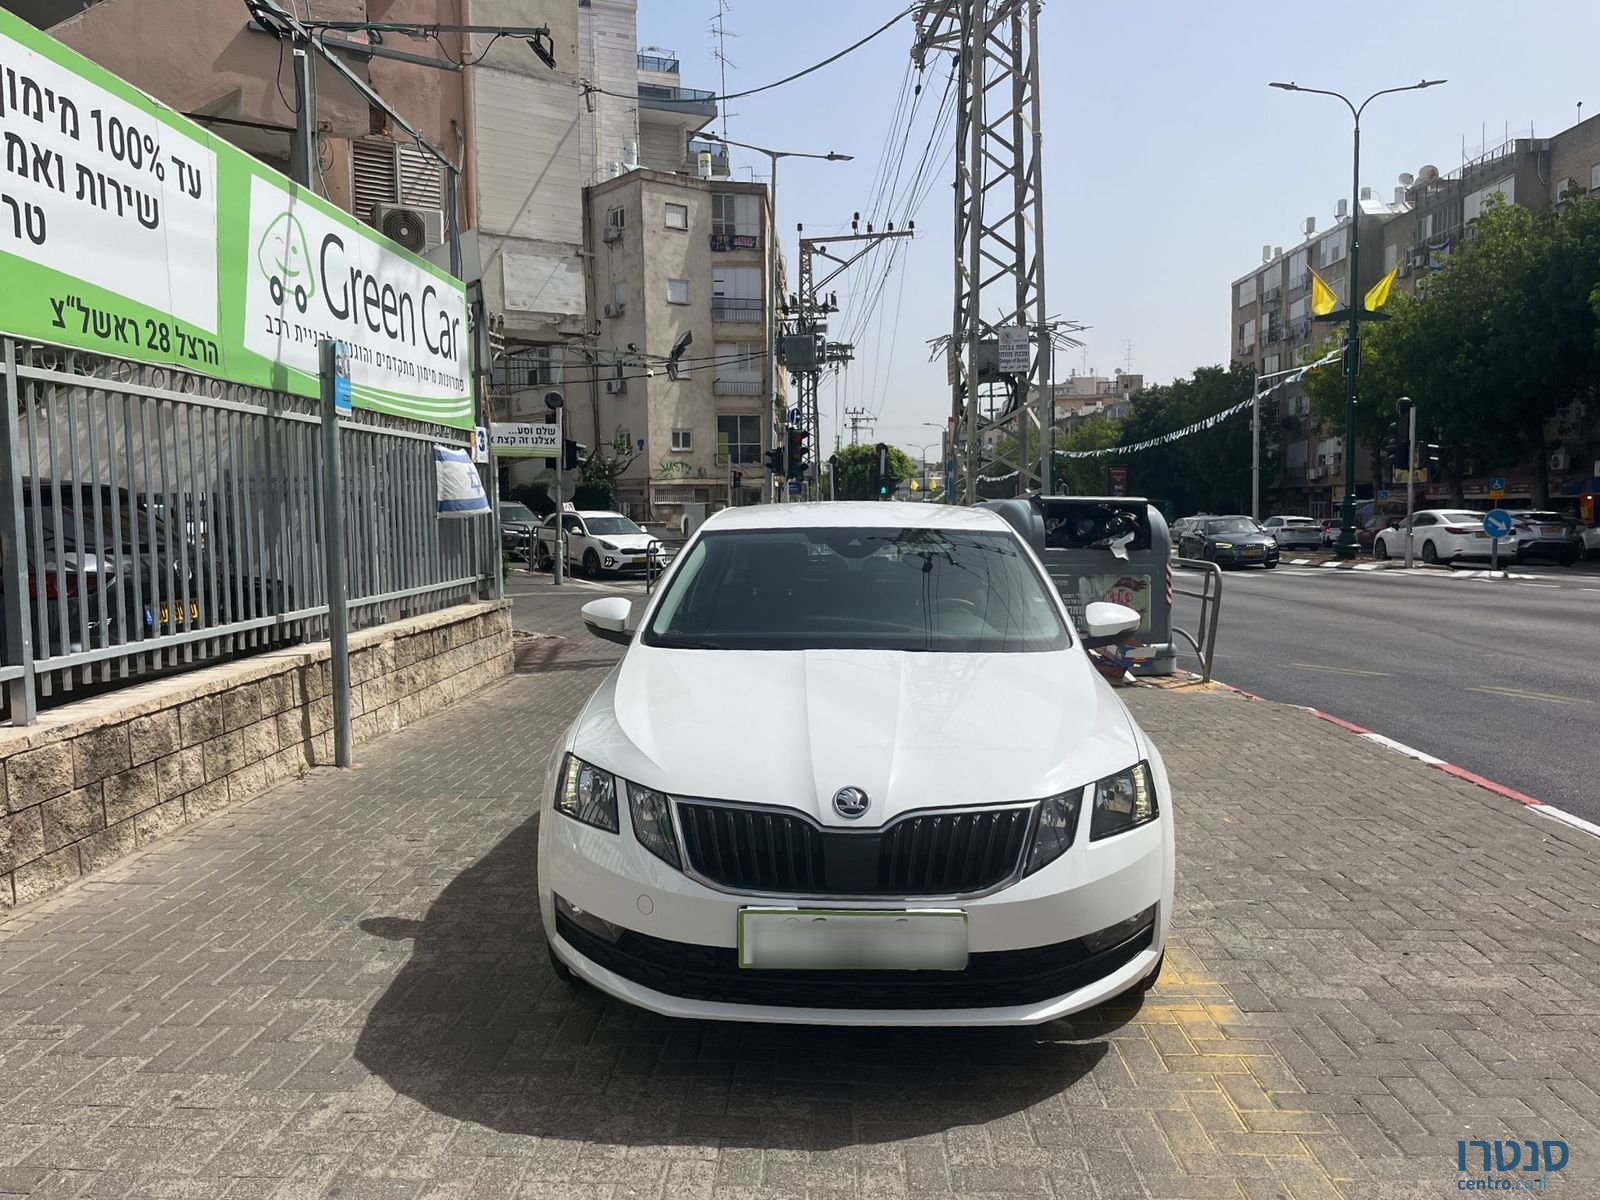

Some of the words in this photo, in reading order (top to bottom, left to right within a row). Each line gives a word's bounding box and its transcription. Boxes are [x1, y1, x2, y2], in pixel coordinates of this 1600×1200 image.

[90, 109, 165, 182] 100%
[171, 155, 202, 200] עד
[75, 162, 159, 230] שירות
[319, 232, 416, 346] Green
[421, 284, 460, 362] Car
[145, 319, 171, 353] 28
[265, 314, 290, 339] רכב
[175, 325, 219, 366] הרצל
[337, 339, 373, 365] והוגנ
[376, 351, 415, 377] מתקדמים
[417, 365, 437, 383] מימון
[438, 371, 464, 392] פתרונות
[496, 436, 516, 447] קצת
[518, 436, 529, 445] זה
[530, 435, 556, 445] אצלנו
[535, 426, 556, 436] שלם
